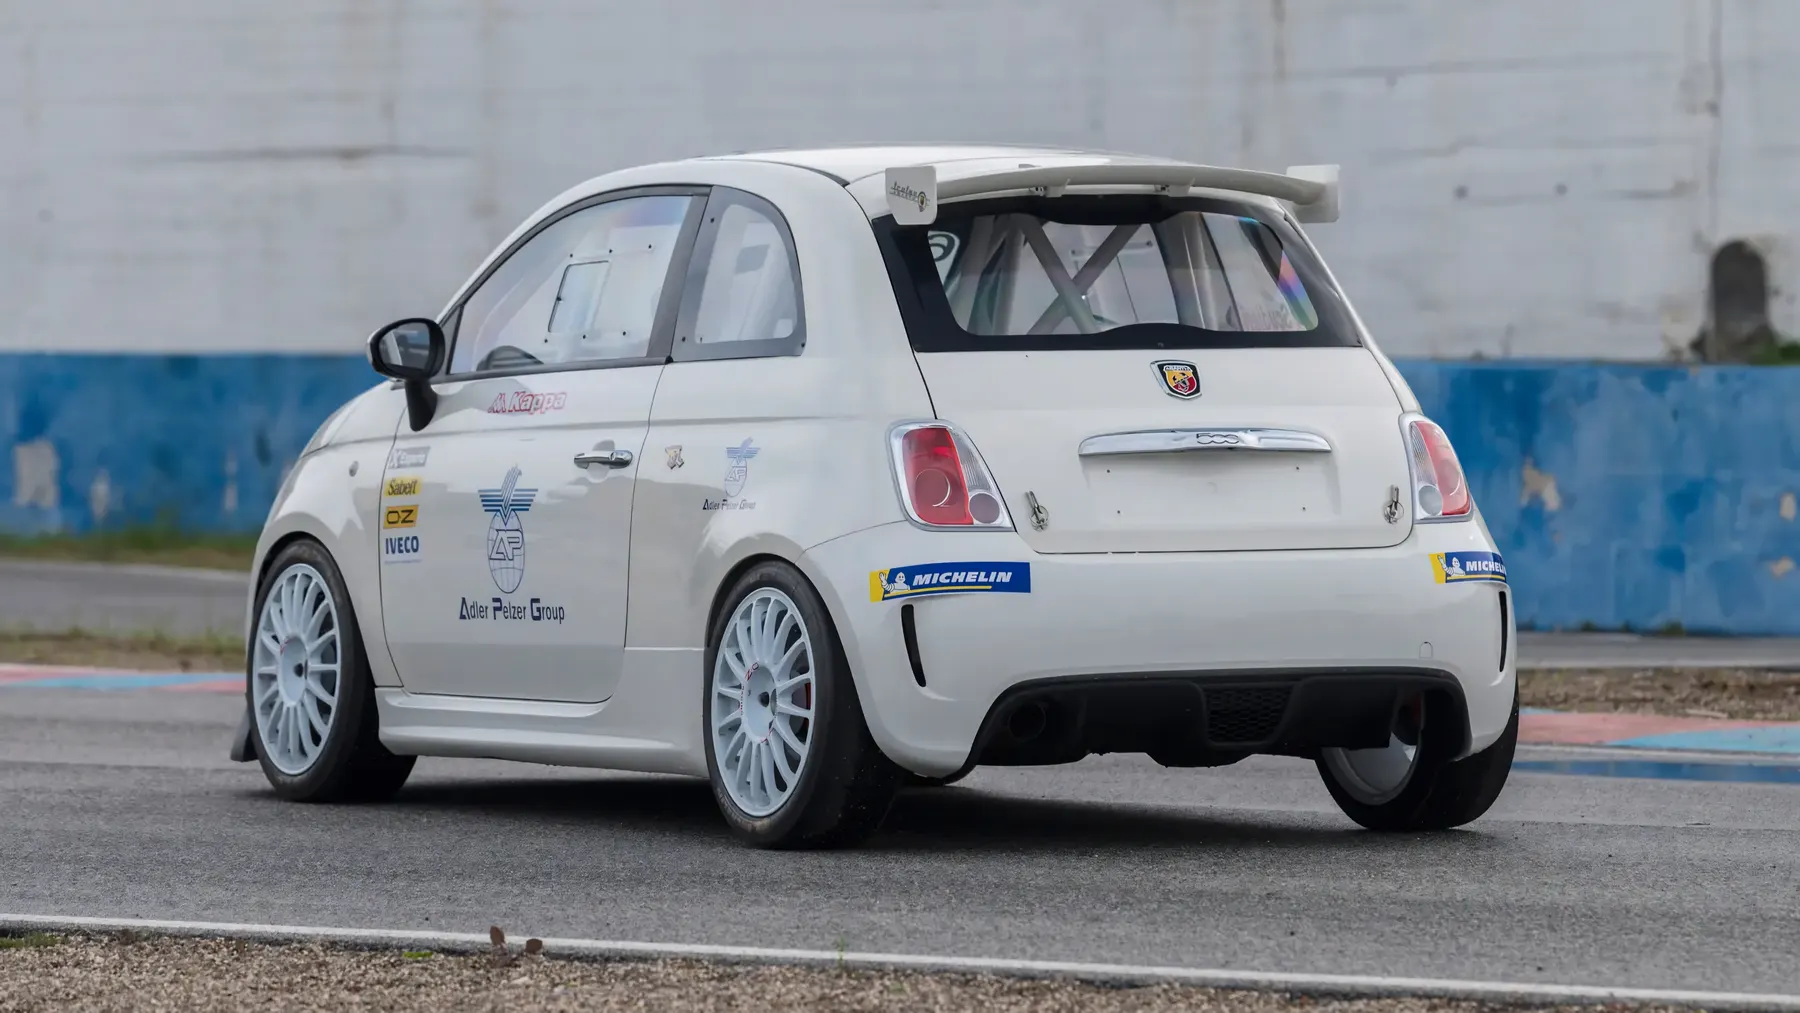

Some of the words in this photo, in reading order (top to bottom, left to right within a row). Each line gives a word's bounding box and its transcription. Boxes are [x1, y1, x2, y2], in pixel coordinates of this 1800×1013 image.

[508, 391, 567, 415] Kappa
[1195, 432, 1240, 445] 500
[386, 509, 415, 525] OZ
[385, 536, 420, 555] IVECO
[912, 571, 1013, 586] MICHELIN
[459, 597, 488, 620] Adler
[492, 597, 526, 621] Pelzer
[530, 598, 565, 624] Group
